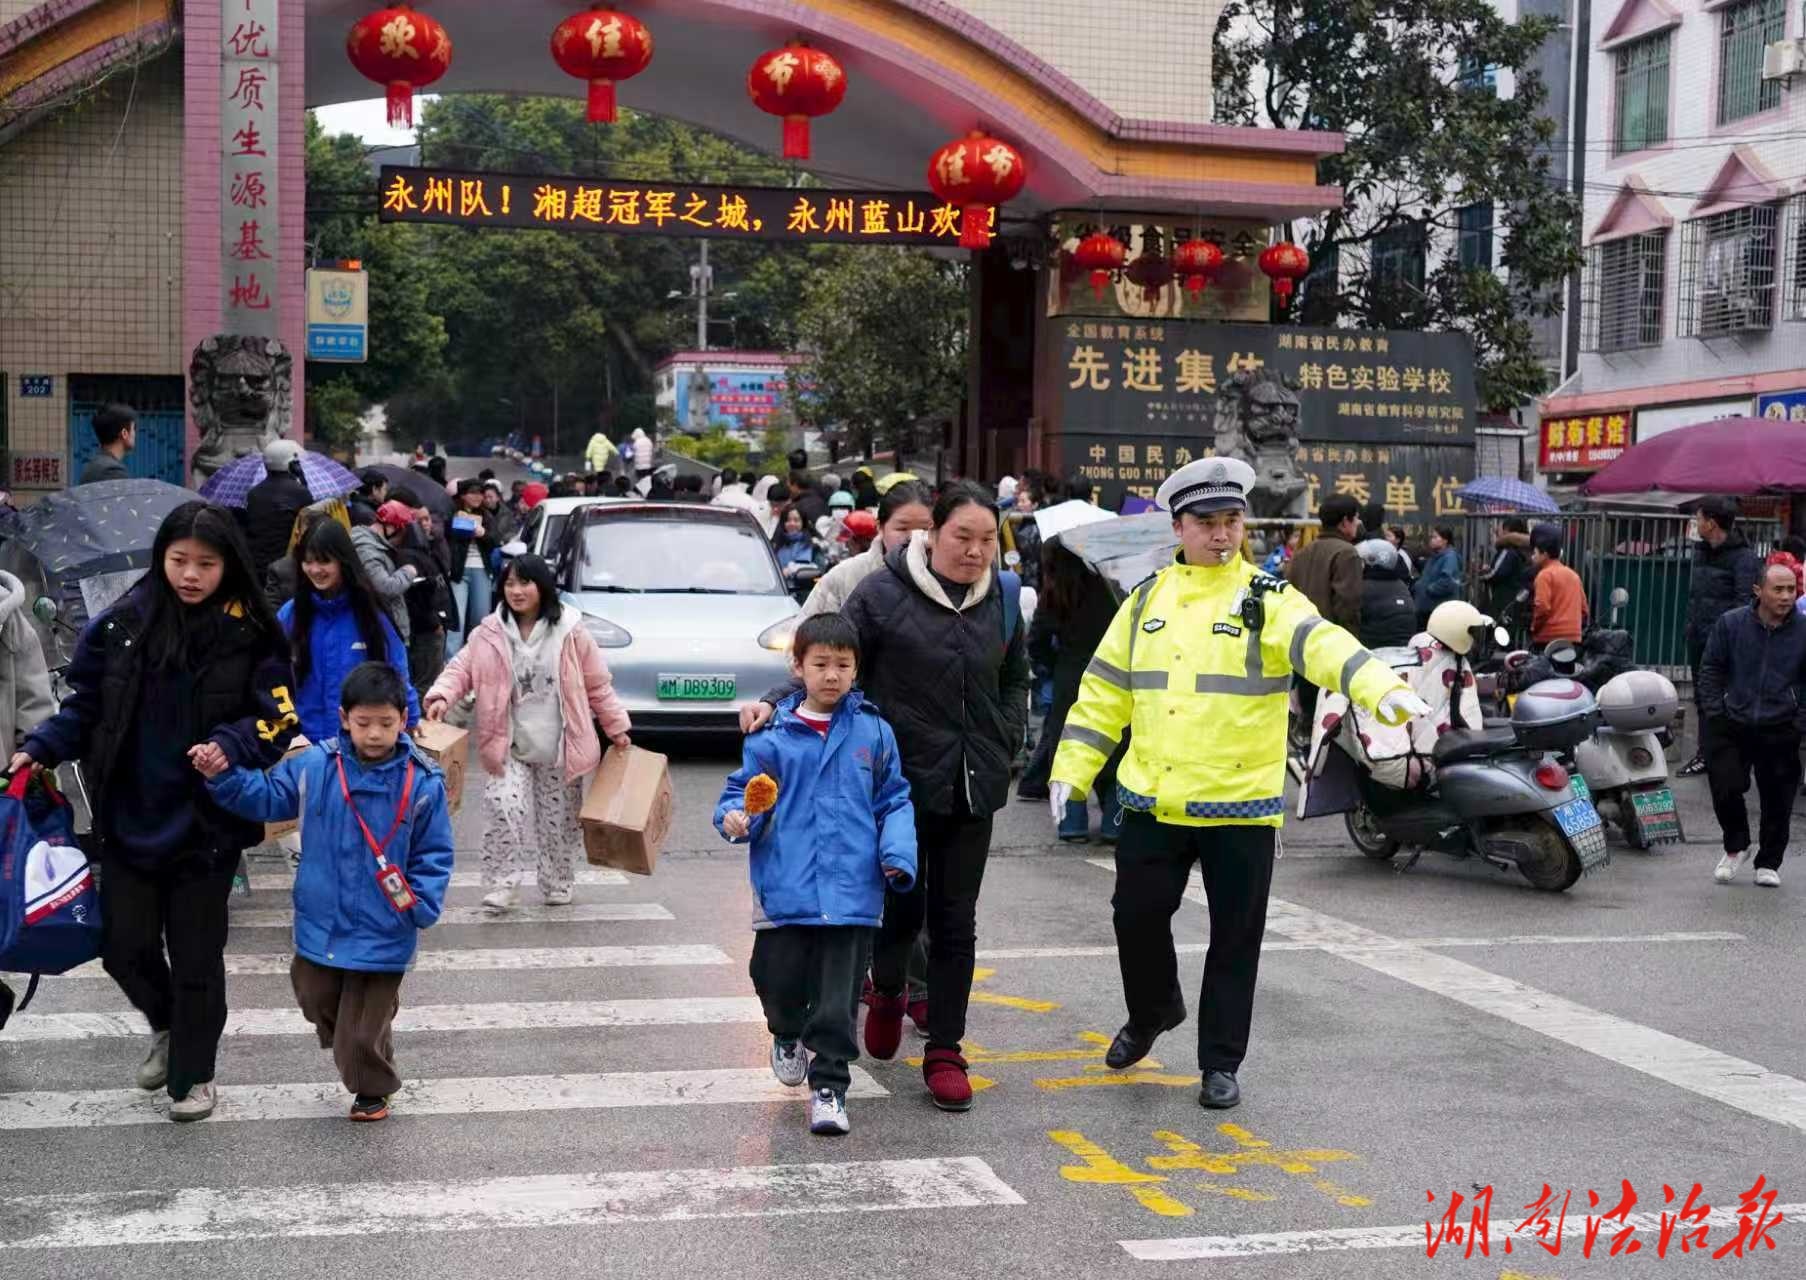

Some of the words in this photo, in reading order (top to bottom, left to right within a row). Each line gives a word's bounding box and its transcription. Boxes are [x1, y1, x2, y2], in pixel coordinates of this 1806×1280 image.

[1299, 362, 1452, 393] 特色实验学校
[1119, 467, 1140, 480] GUO
[1145, 468, 1165, 480] MIN
[684, 679, 734, 695] D89309
